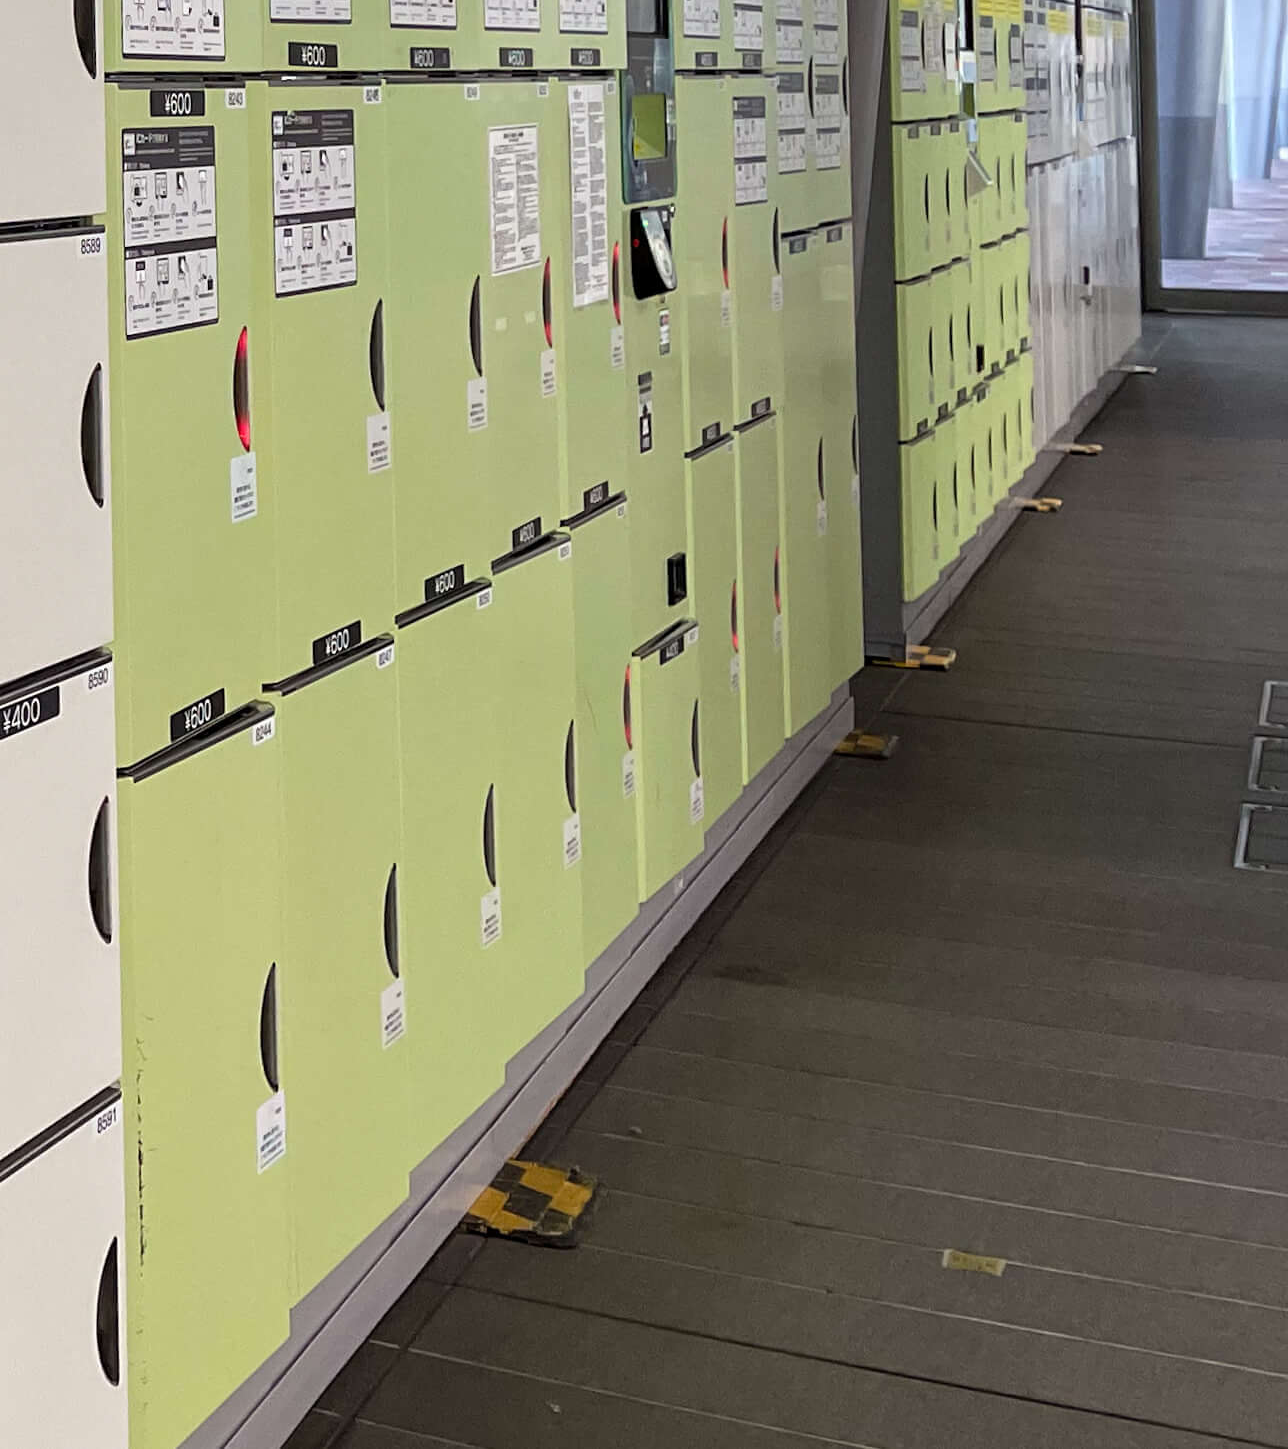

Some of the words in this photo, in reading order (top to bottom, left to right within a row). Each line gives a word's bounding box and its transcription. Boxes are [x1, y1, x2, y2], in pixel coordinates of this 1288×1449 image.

[301, 45, 326, 66] ¥600
[164, 93, 192, 115] ¥600
[227, 90, 244, 107] 8243
[80, 236, 102, 255] 8589
[434, 569, 456, 594] ¥600
[324, 628, 350, 656] ¥600
[88, 668, 109, 690] 8590
[3, 698, 41, 734] ¥400
[184, 699, 212, 731] ¥600
[255, 720, 272, 742] 8244
[97, 1108, 117, 1134] 8591
